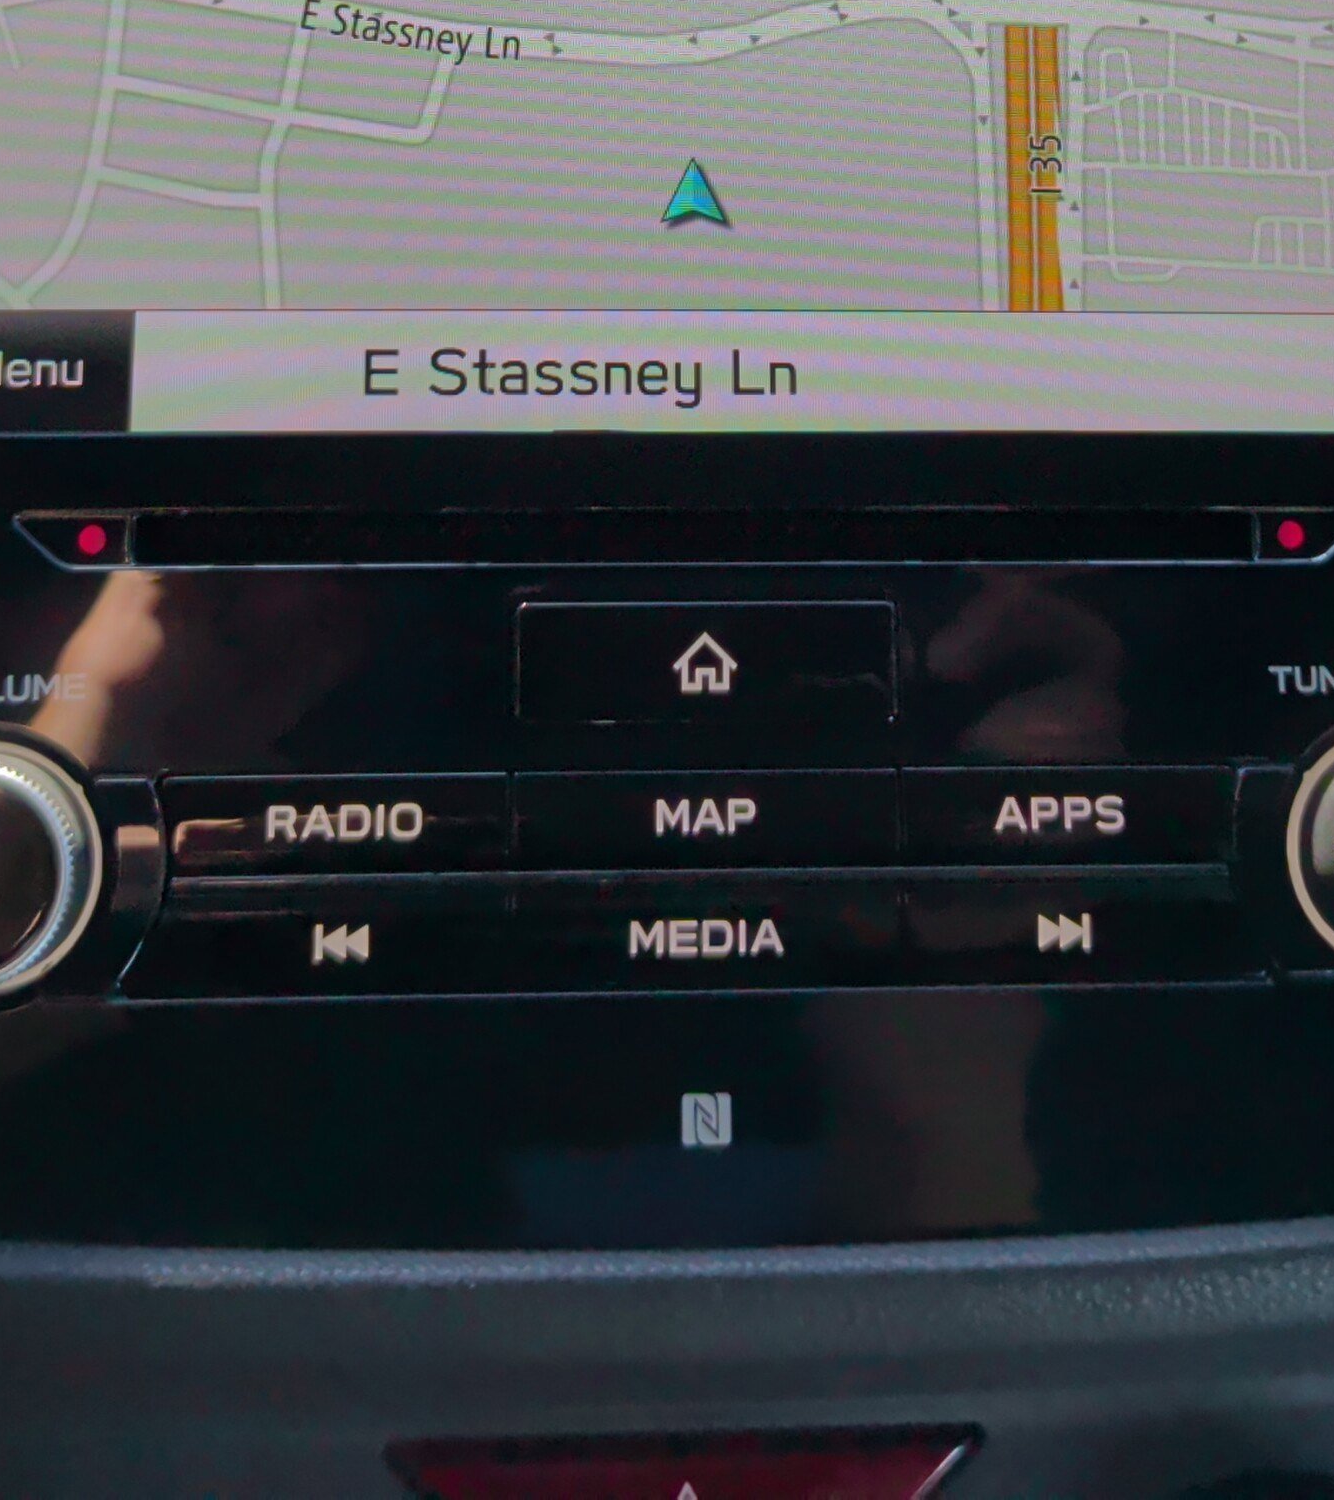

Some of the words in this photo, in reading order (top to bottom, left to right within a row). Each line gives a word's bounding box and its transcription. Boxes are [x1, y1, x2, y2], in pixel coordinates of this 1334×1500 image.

[330, 3, 474, 66] Stassney
[485, 26, 521, 61] Ln
[364, 348, 399, 396] E
[429, 346, 702, 409] Stassney
[731, 348, 798, 396] Ln
[266, 802, 424, 842] RADIO
[654, 797, 757, 836] MAP
[994, 794, 1127, 836] APPS
[628, 917, 785, 959] MEDIA
